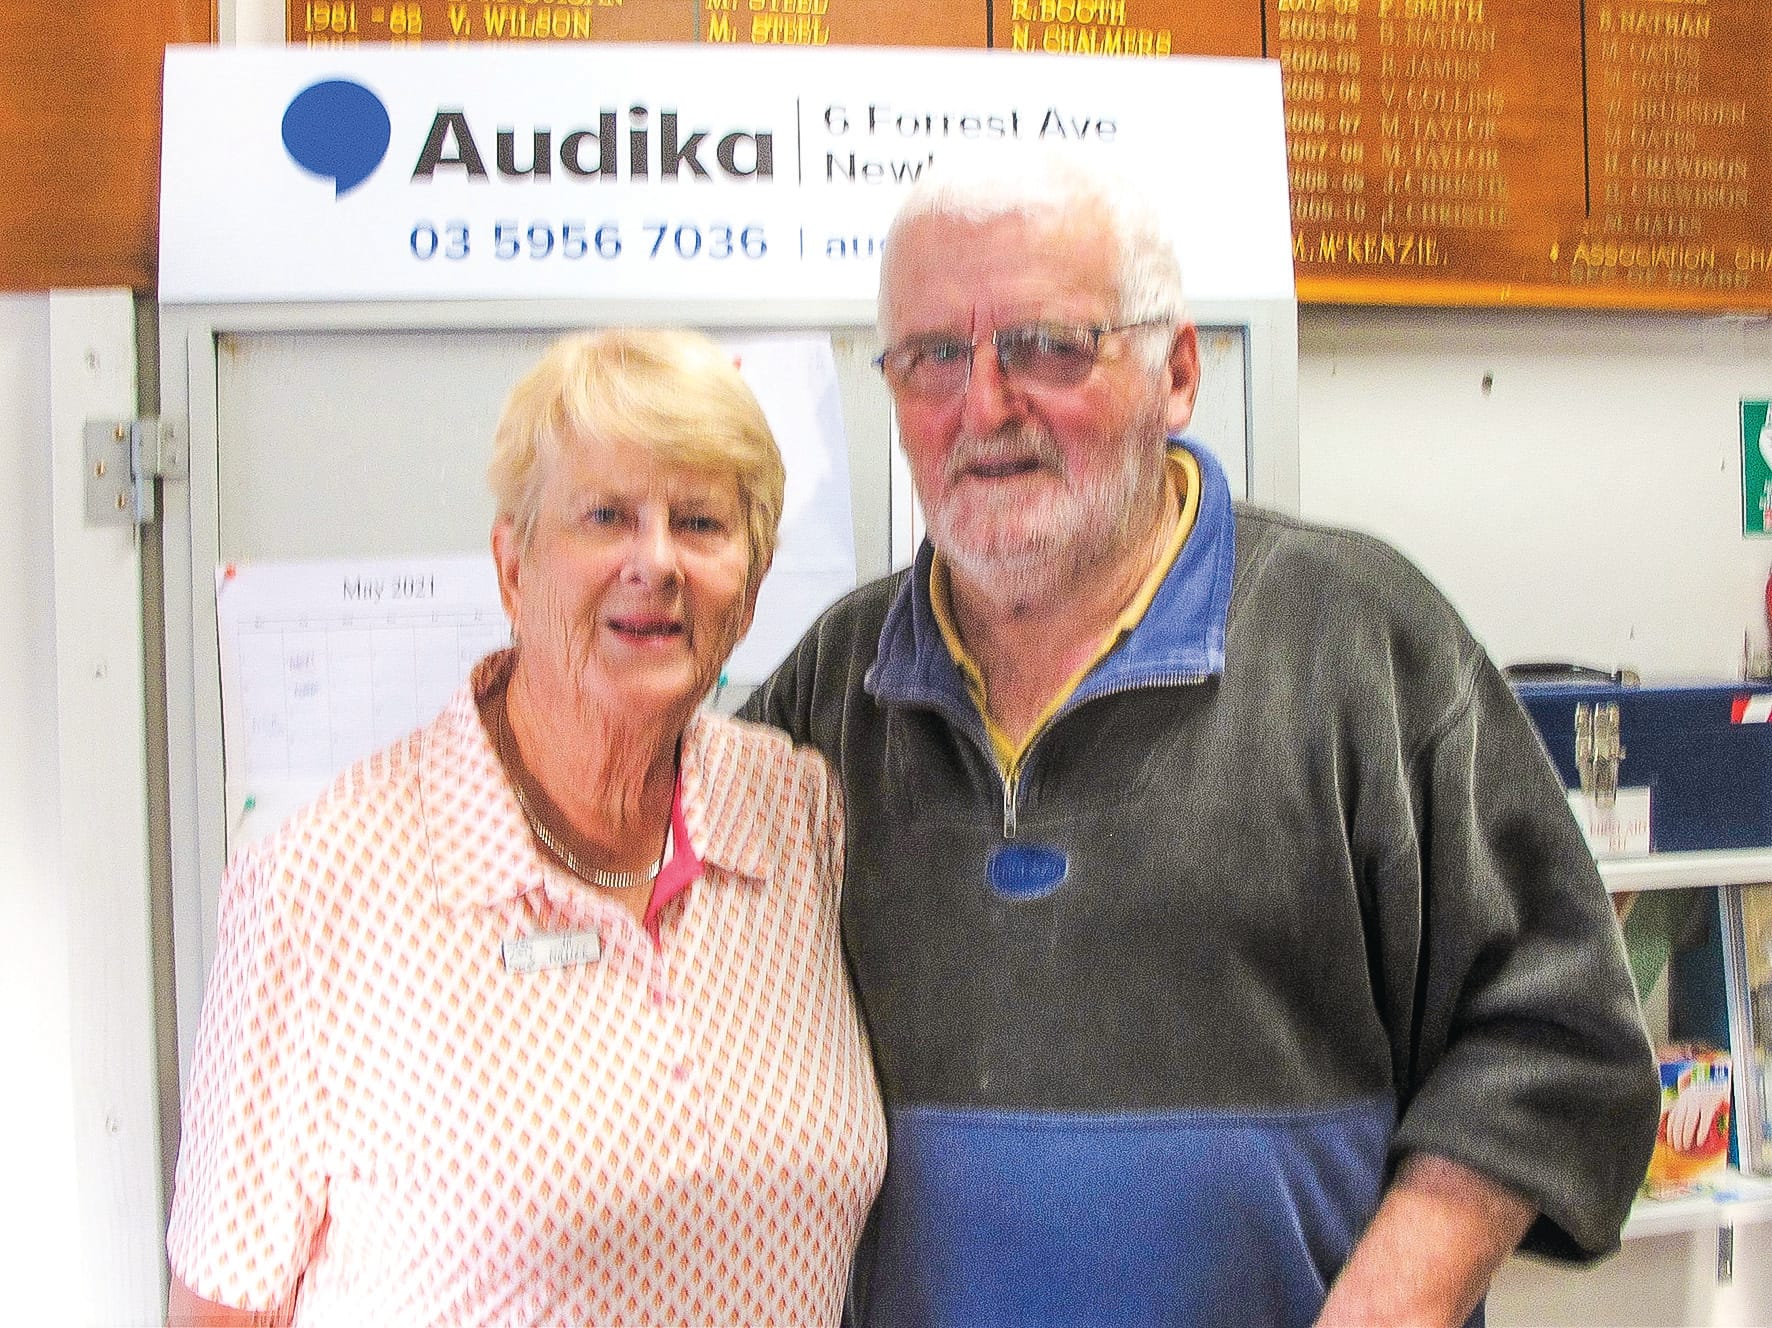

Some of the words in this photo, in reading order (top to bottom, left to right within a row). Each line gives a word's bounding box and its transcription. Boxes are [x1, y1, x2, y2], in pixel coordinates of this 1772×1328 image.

[482, 4, 593, 39] WILSON
[410, 102, 775, 184] Audika
[824, 103, 849, 137] 6
[867, 103, 1019, 139] Forrest
[1038, 103, 1118, 143] Ave
[409, 221, 471, 260] 03
[494, 219, 623, 260] 5956
[643, 220, 769, 260] 7036
[342, 576, 385, 604] May
[391, 573, 435, 599] 2021
